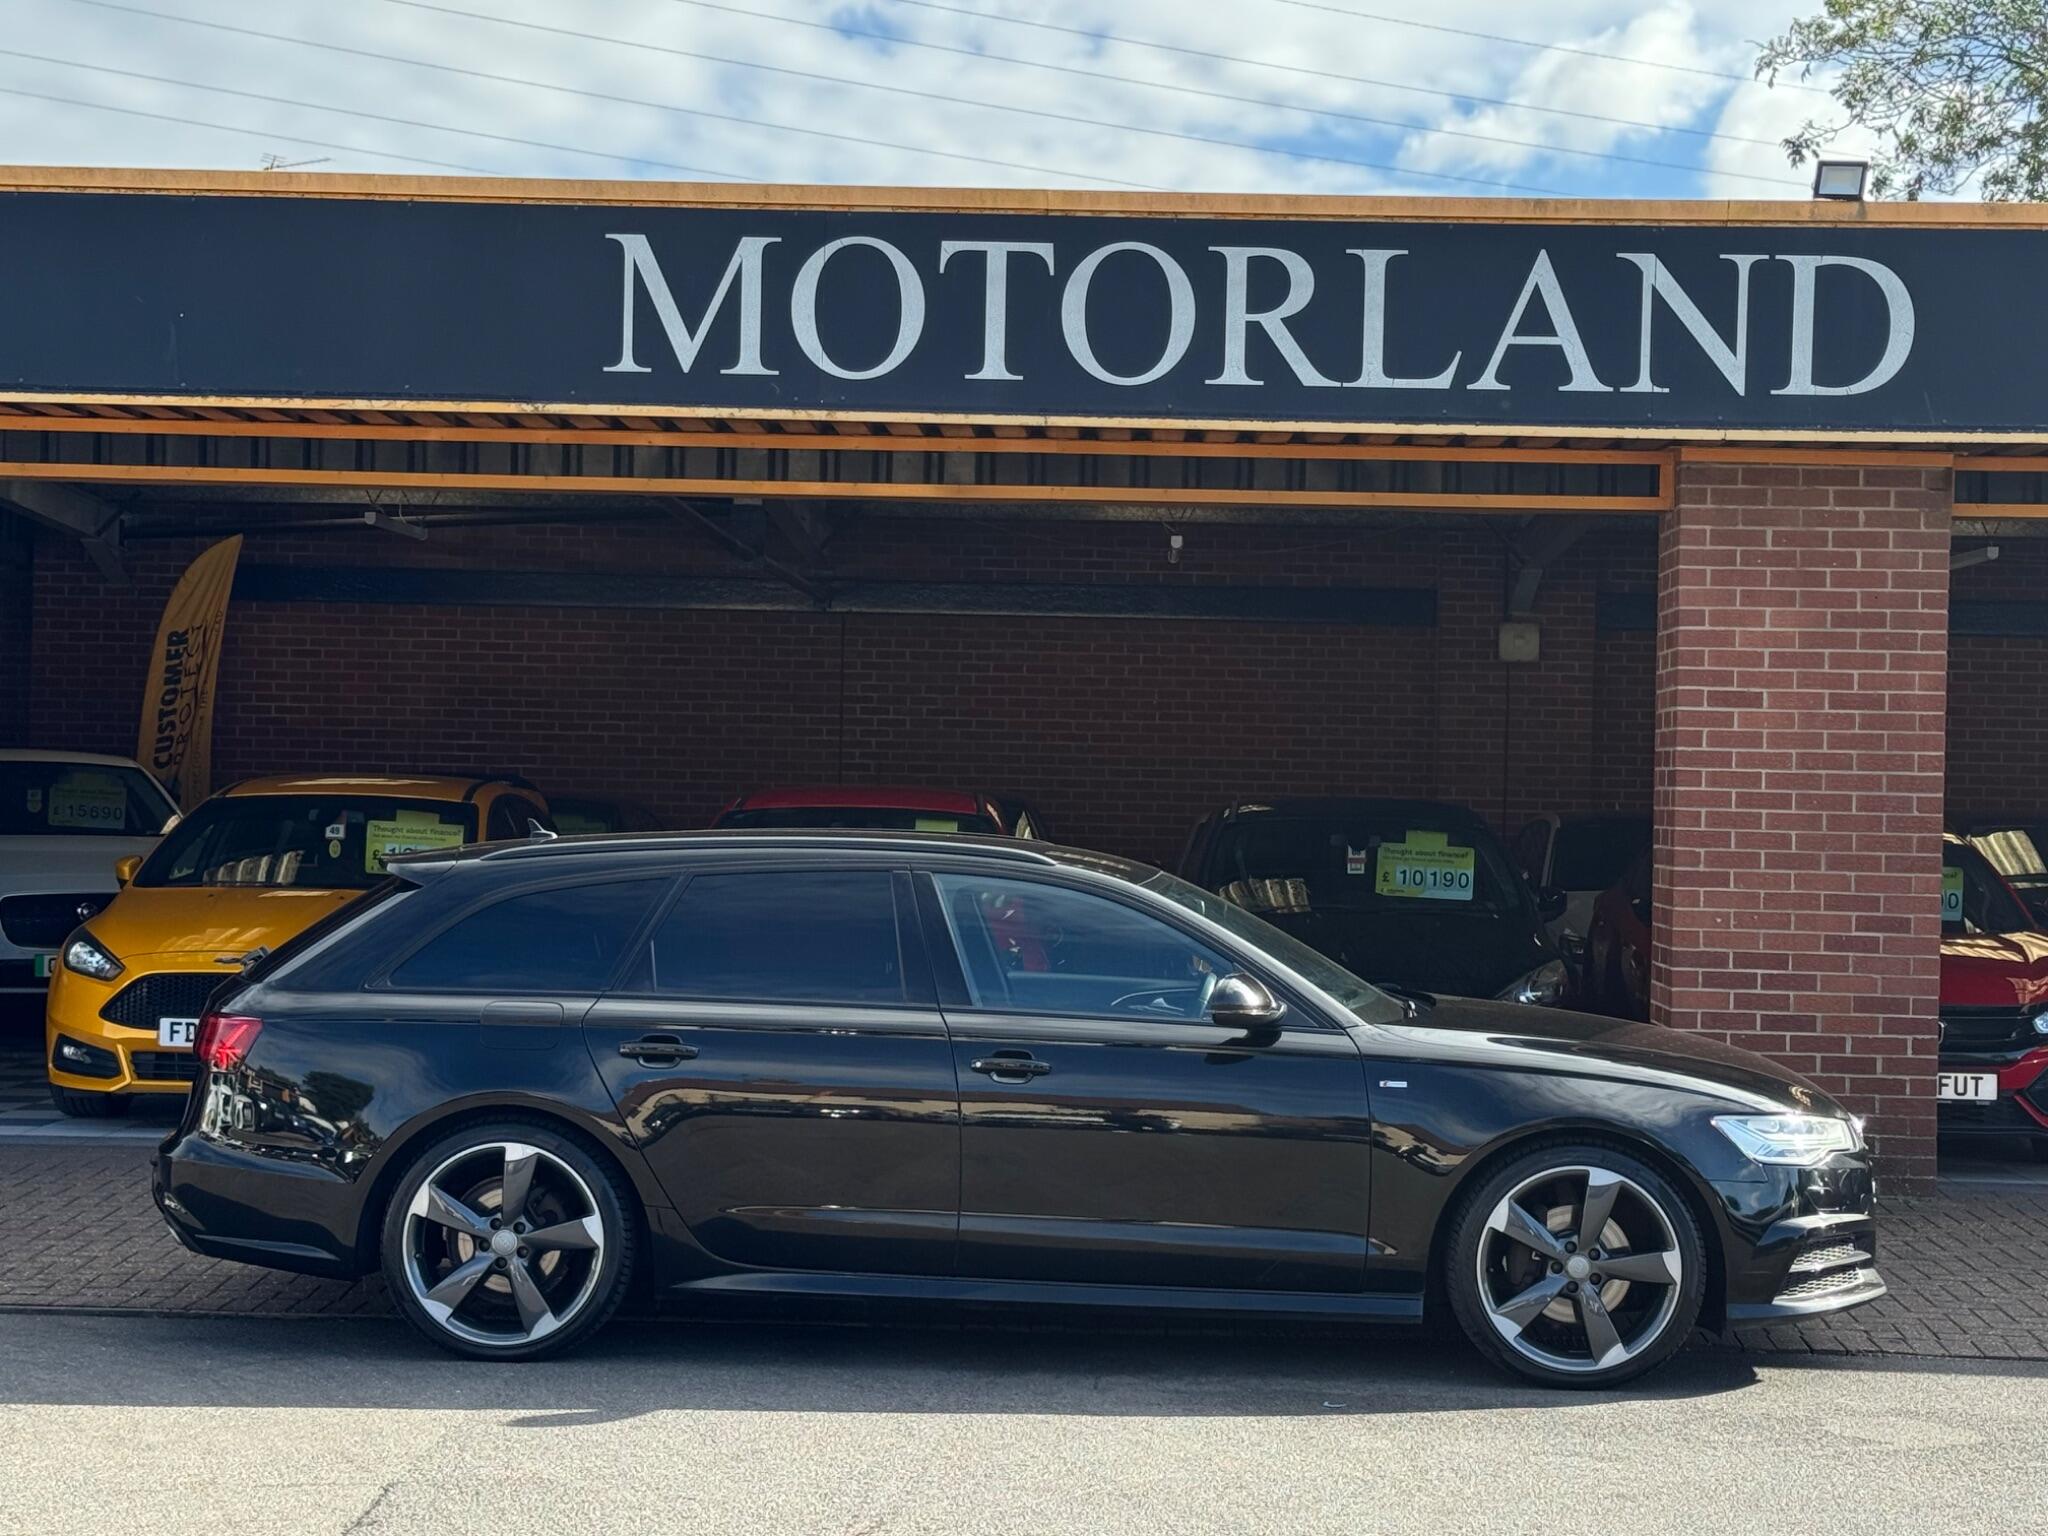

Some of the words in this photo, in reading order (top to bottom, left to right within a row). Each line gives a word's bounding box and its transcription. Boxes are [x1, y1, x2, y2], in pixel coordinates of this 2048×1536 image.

[603, 232, 1916, 398] MOTORLAND
[153, 629, 188, 770] CUSTOMER
[373, 825, 404, 835] Thought
[406, 826, 428, 834] about
[430, 828, 461, 836] finance?
[1383, 846, 1412, 857] Thought
[1415, 849, 1437, 857] about
[1382, 872, 1390, 882] £
[1400, 869, 1469, 889] 10190
[170, 1021, 197, 1042] FD
[1938, 1075, 1983, 1097] FUT
